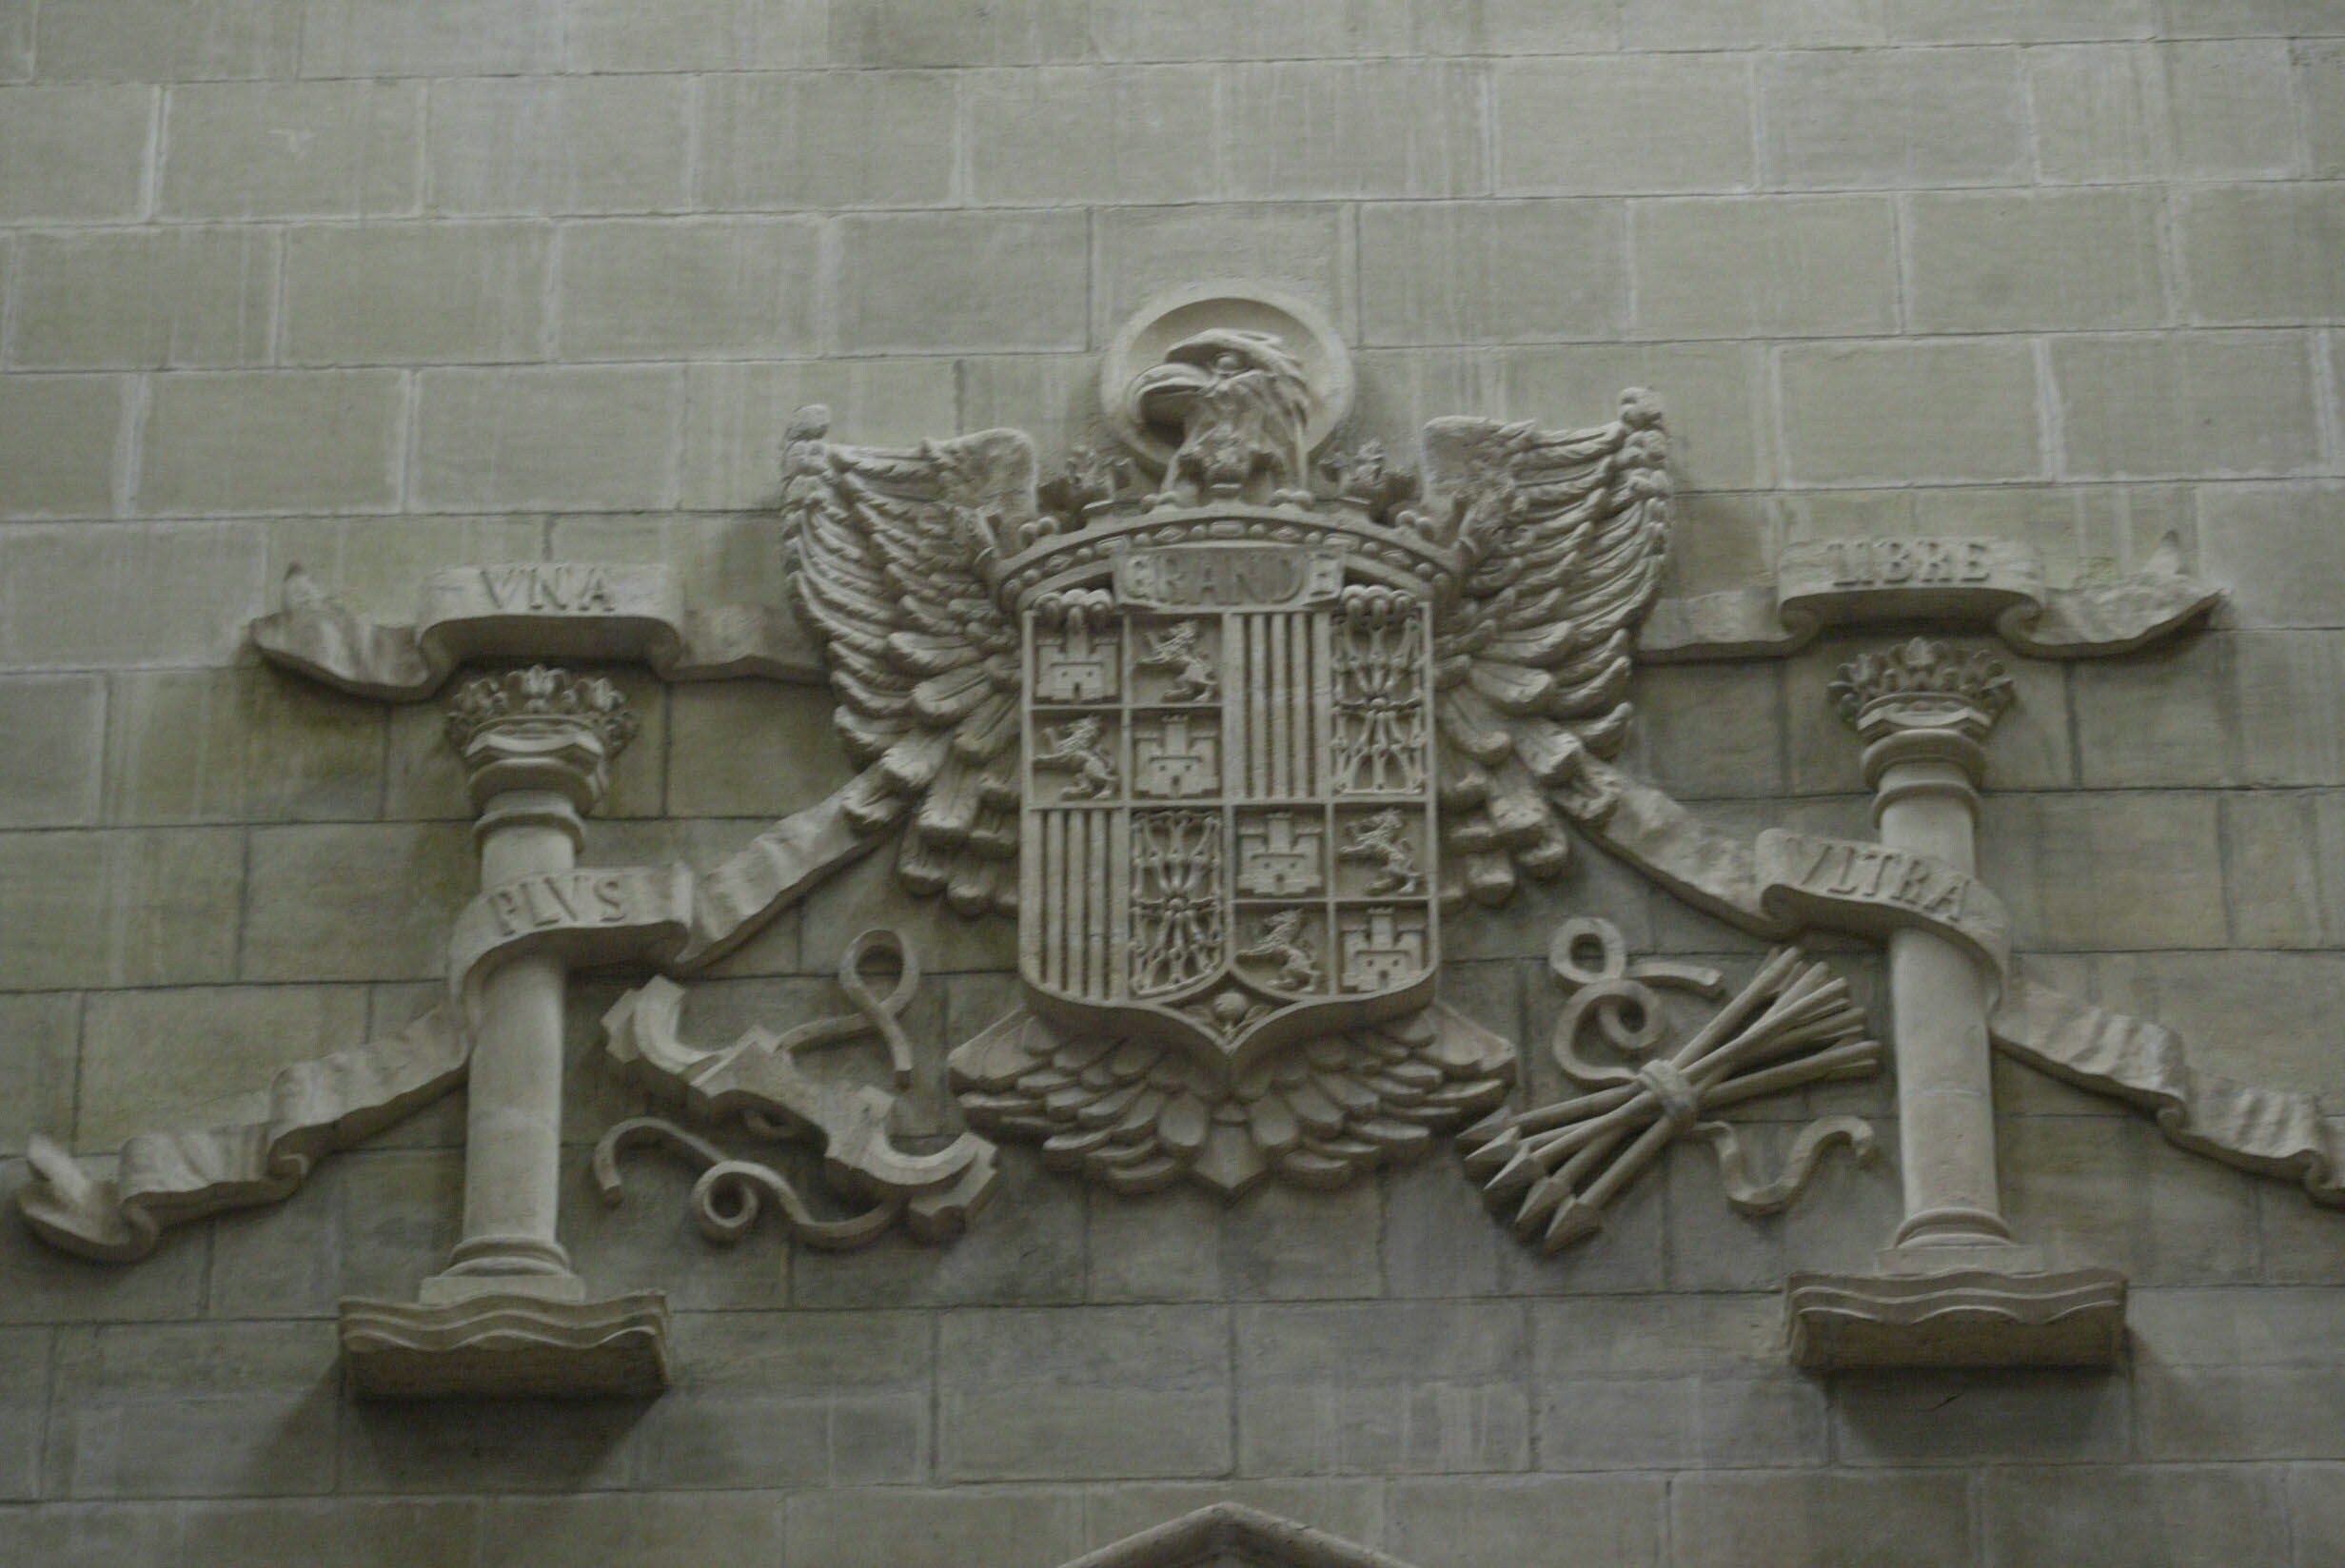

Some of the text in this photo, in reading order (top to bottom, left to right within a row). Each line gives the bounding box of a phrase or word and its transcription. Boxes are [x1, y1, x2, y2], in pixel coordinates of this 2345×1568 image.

[478, 566, 618, 613] VNA
[1124, 548, 1337, 604] GRANDE
[1825, 539, 1990, 587] LIBRE
[485, 874, 627, 938] PLVS
[1785, 836, 1972, 923] VLTRA
